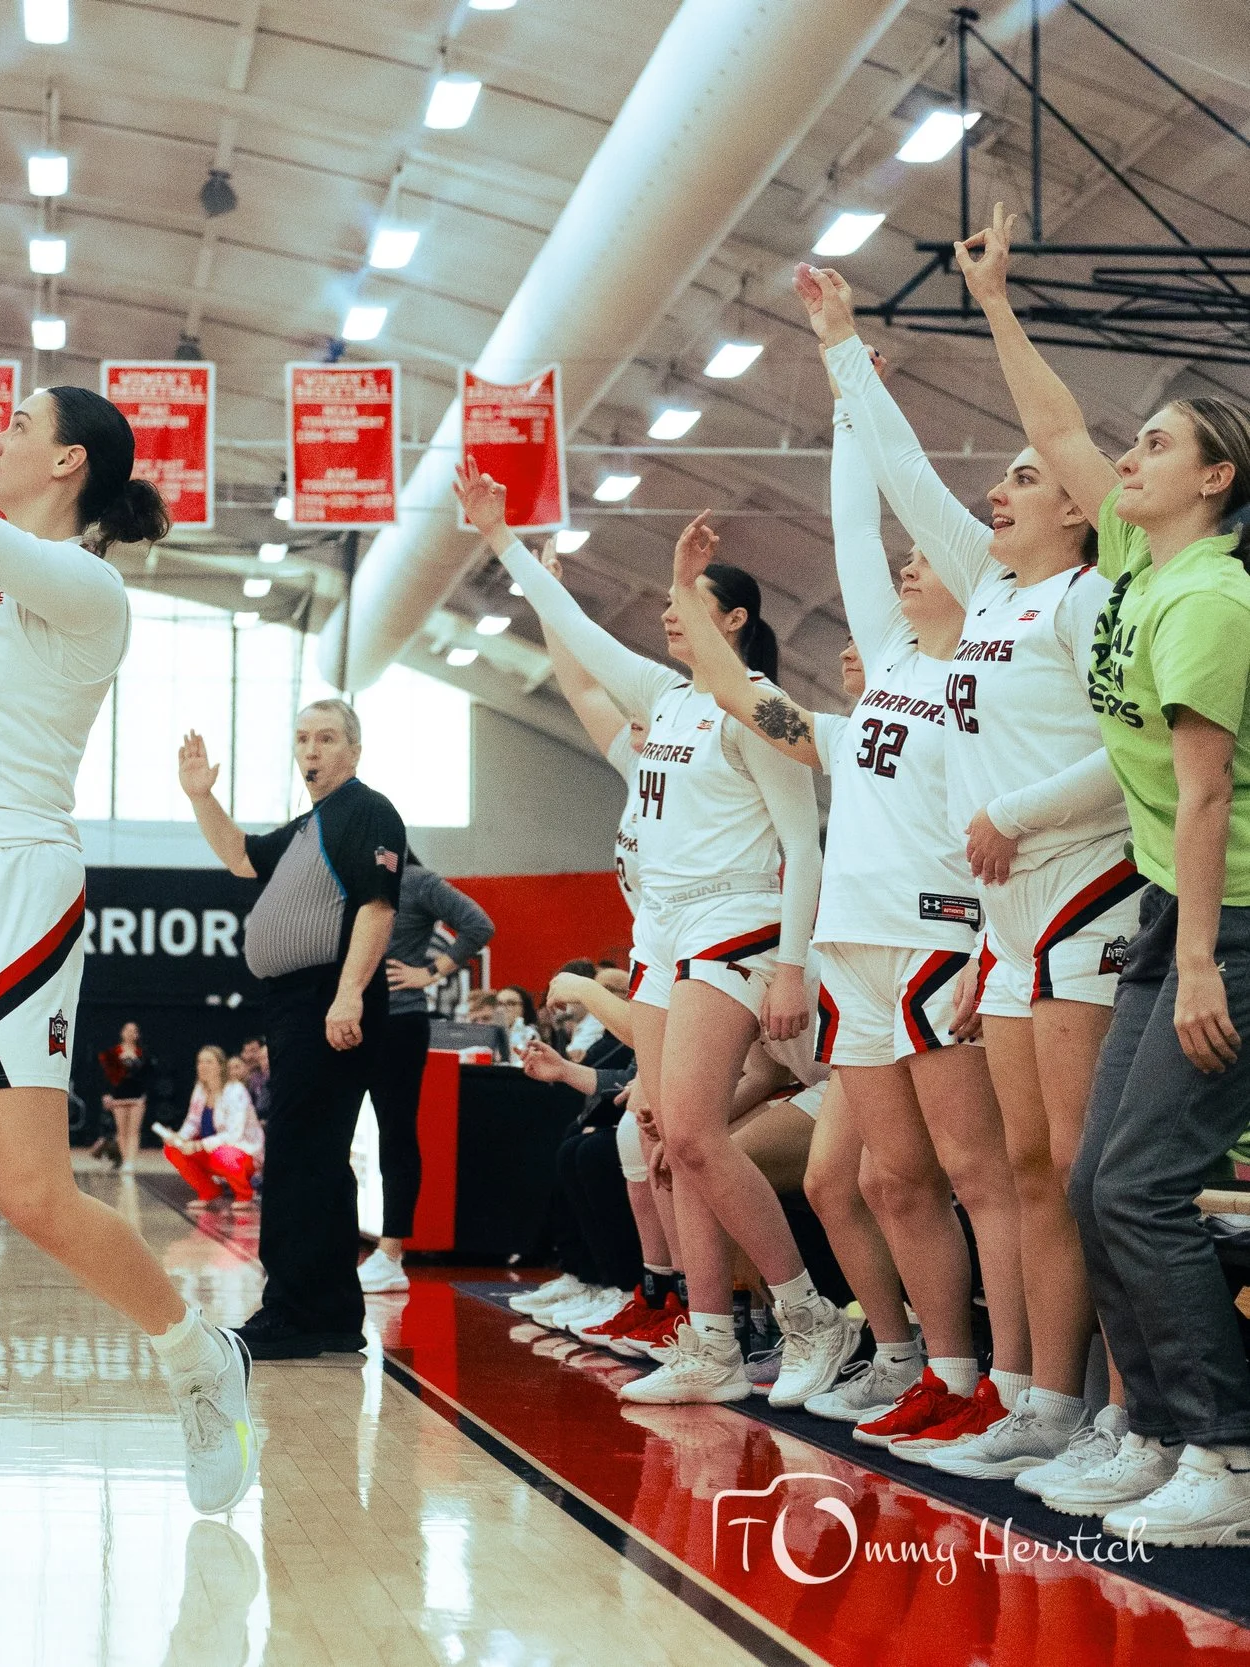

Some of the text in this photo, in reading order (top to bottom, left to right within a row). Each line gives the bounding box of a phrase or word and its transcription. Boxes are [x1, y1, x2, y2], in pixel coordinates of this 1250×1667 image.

[946, 673, 979, 734] 42
[856, 717, 909, 779] 32
[639, 769, 666, 820] 44
